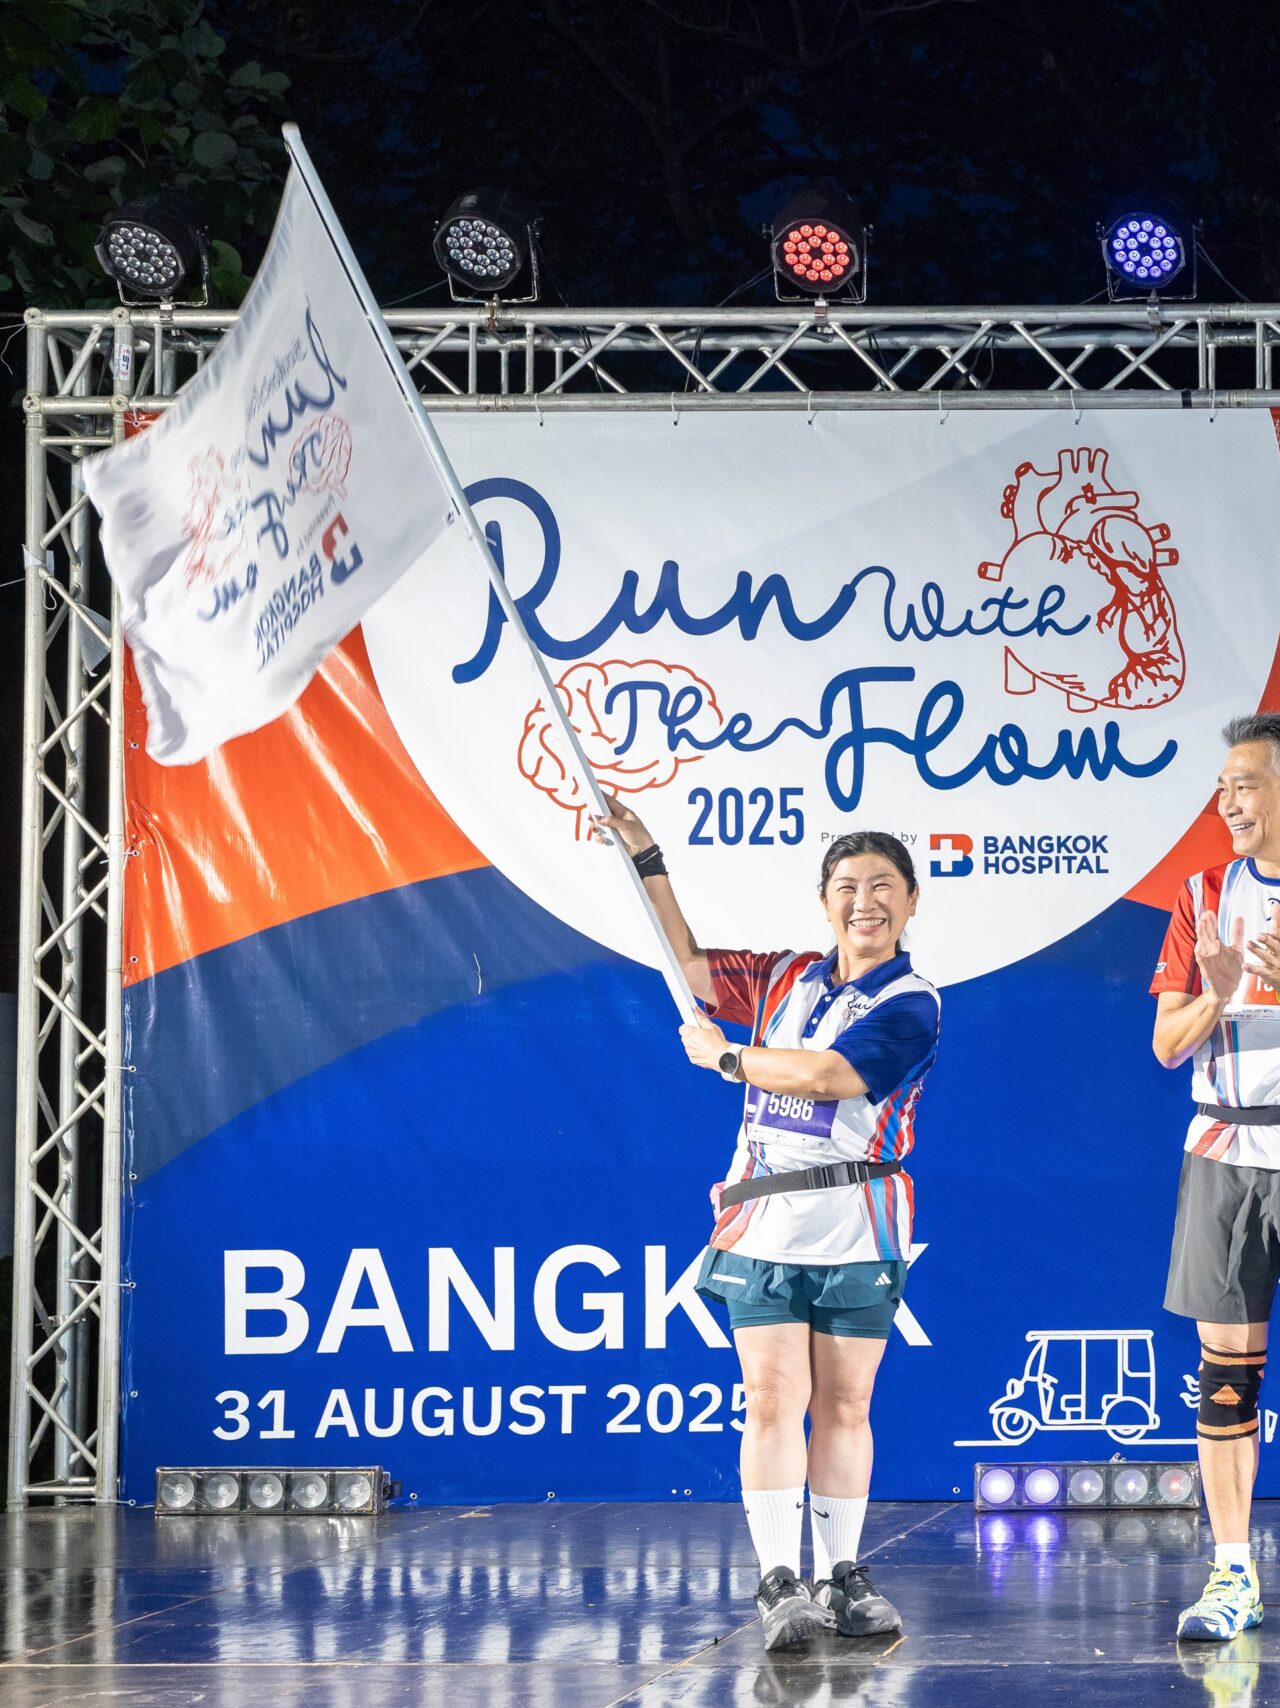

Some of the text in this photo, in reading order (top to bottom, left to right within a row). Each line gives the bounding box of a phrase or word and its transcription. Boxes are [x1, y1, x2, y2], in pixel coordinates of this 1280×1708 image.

[453, 477, 858, 684] Run
[605, 666, 1178, 812] The Flow
[688, 787, 805, 846] 2025
[901, 832, 918, 845] by
[984, 834, 1109, 854] BANGKOK
[984, 855, 1109, 875] HOSPITAL
[768, 1095, 815, 1121] 5986
[224, 1243, 934, 1355] BANGK
[213, 1390, 295, 1441] 31
[314, 1384, 587, 1439] AUGUST
